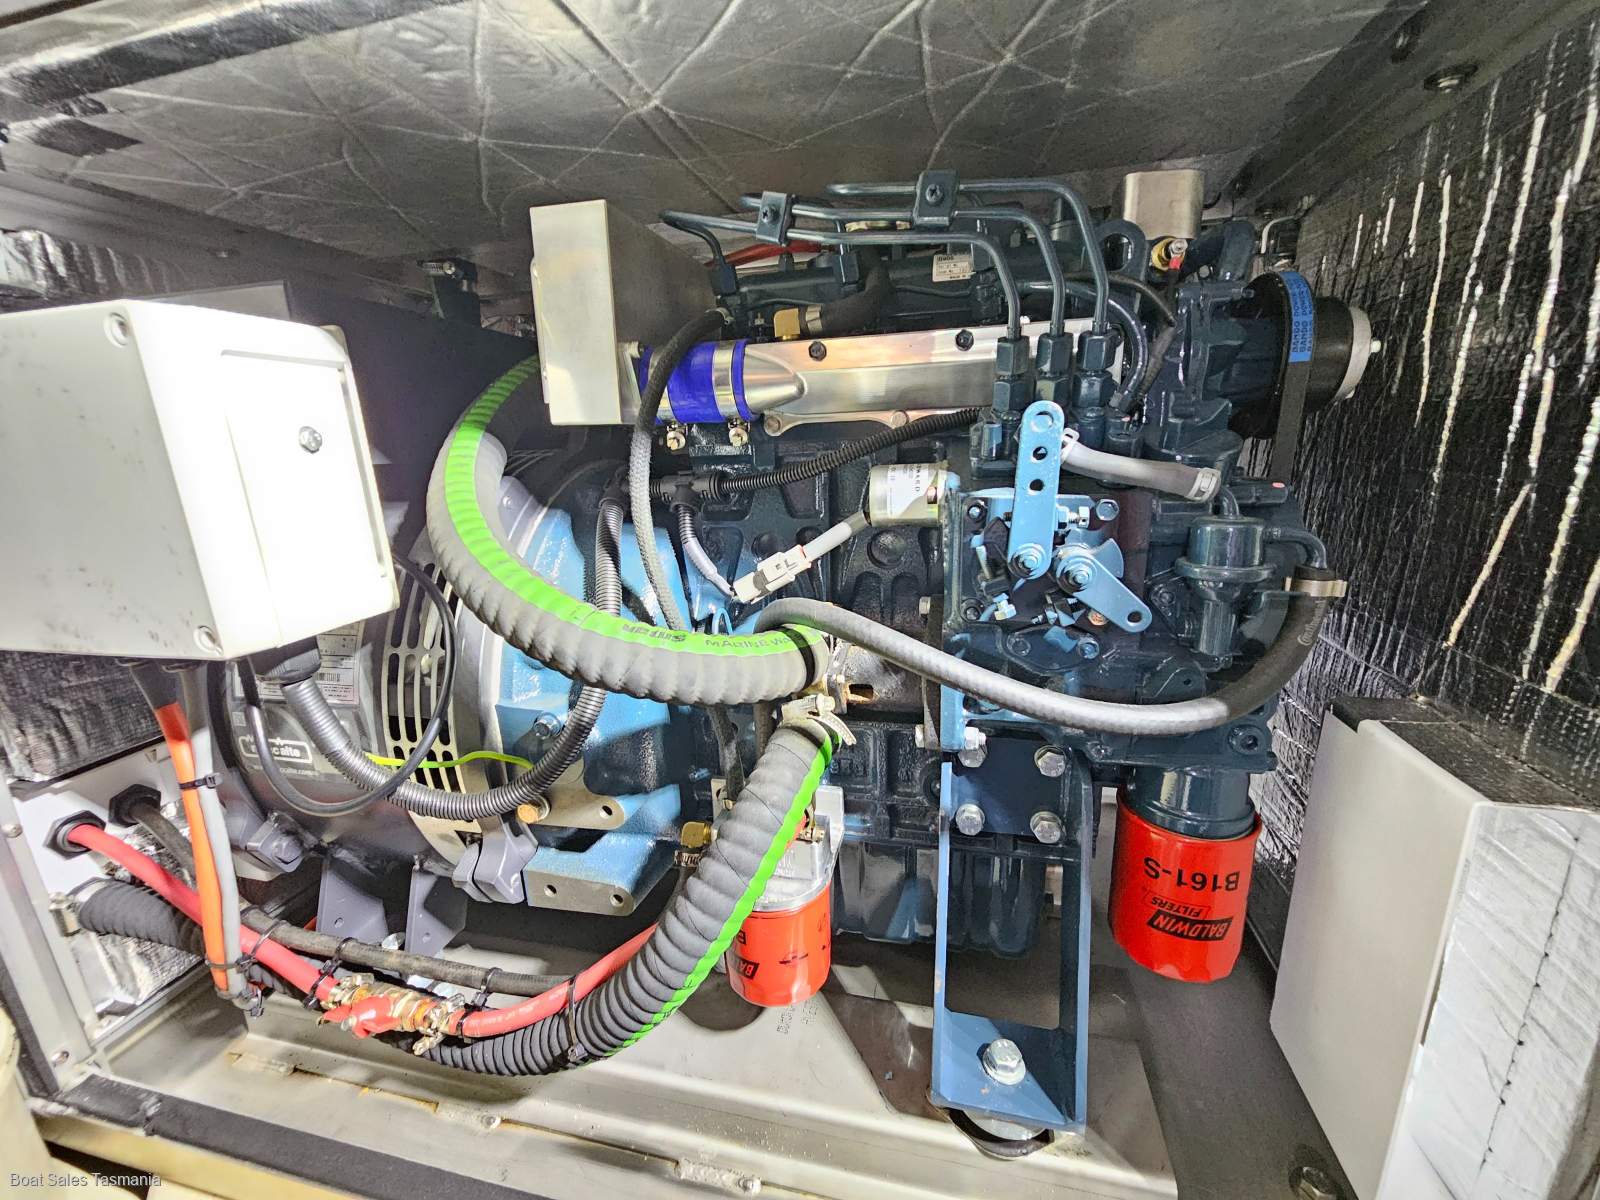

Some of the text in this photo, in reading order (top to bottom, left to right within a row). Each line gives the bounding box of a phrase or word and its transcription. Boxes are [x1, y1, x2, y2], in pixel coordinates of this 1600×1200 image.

[1143, 856, 1241, 892] B161-S
[1151, 896, 1203, 918] FILTERS
[1152, 914, 1230, 938] BALDWIN
